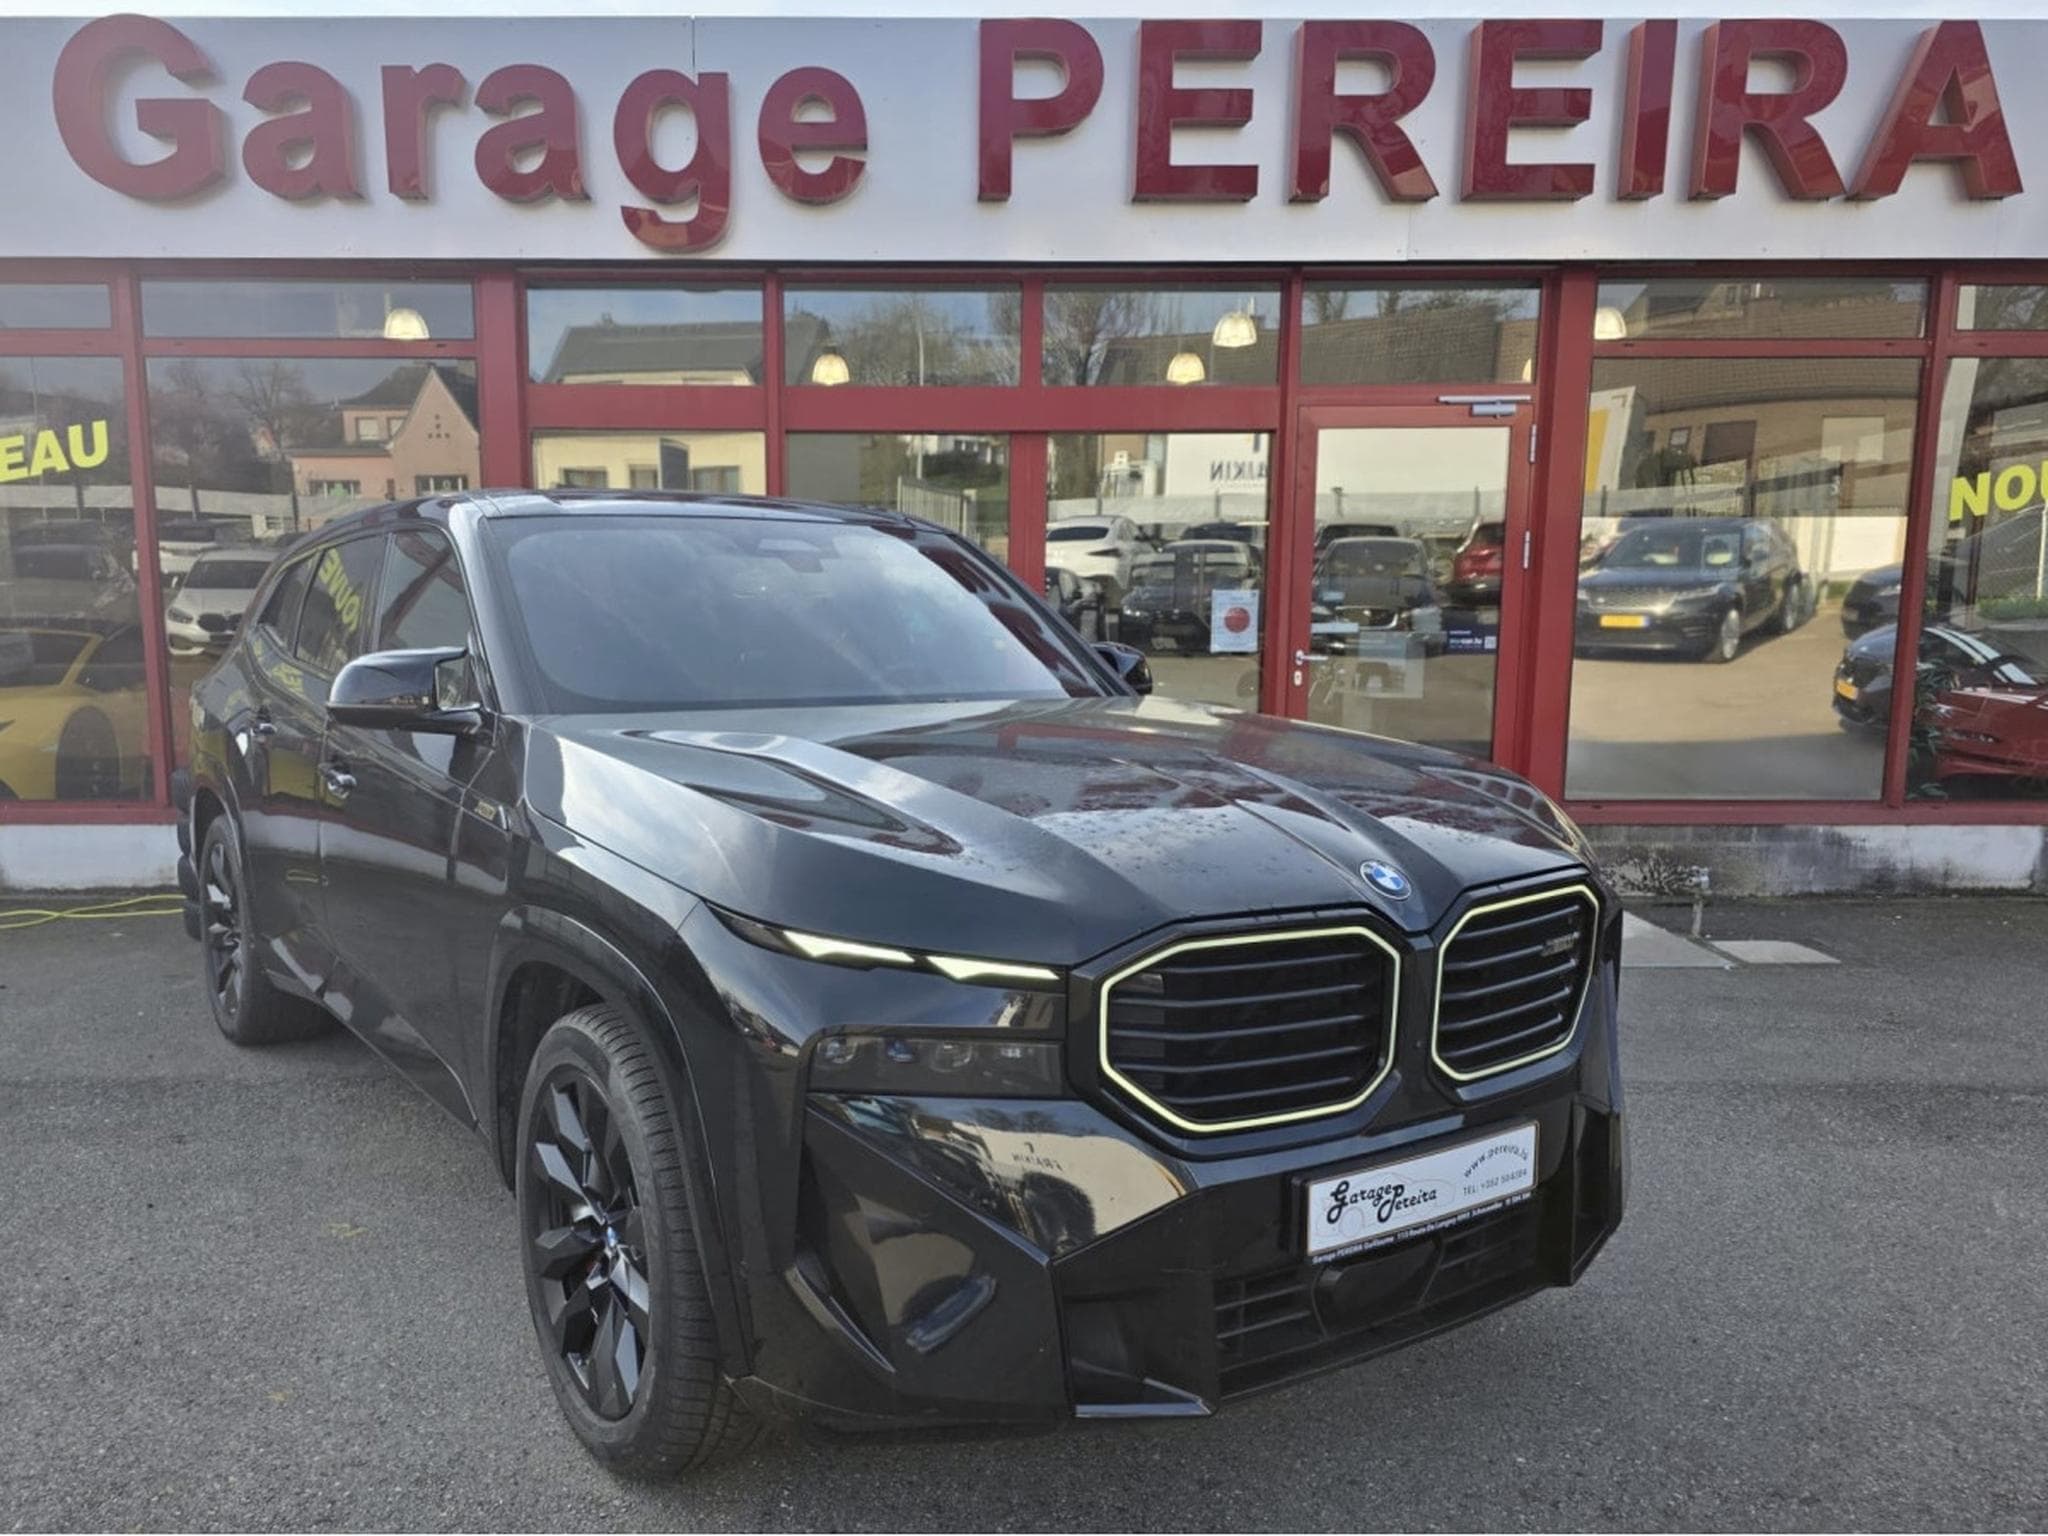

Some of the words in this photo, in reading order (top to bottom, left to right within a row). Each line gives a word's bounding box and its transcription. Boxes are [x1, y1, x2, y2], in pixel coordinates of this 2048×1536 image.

[52, 13, 869, 254] Garage
[976, 17, 2025, 202] PEREIRA
[0, 420, 108, 482] EAU
[1326, 1180, 1394, 1224] Garage
[1377, 1183, 1437, 1223] Pereira
